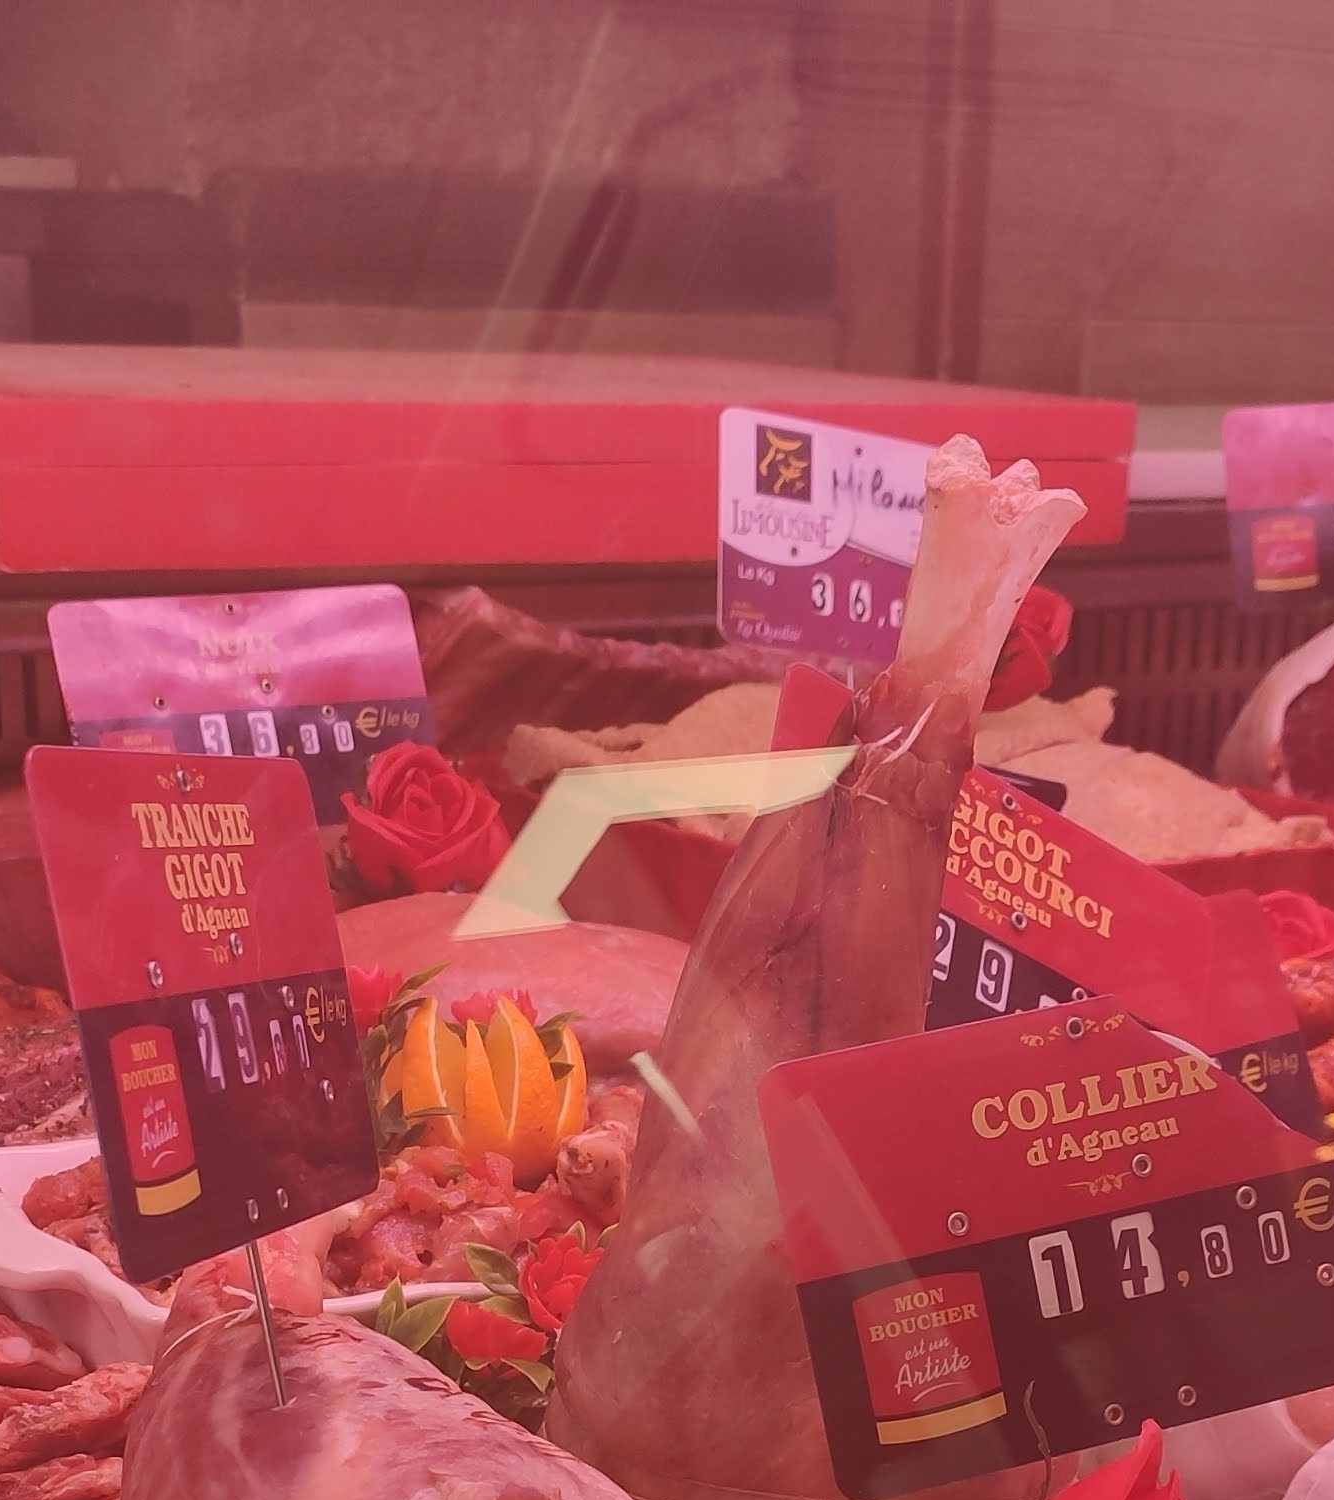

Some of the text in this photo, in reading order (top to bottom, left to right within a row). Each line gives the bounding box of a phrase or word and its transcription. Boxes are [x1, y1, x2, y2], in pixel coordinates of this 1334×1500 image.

[132, 802, 255, 849] TRANCHE
[165, 852, 246, 900] GIGOT
[946, 854, 1052, 929] d'Agneau
[949, 821, 1114, 939] CCOURCI
[182, 903, 250, 940] d'Agneau
[122, 1063, 178, 1092] BOUCHER
[970, 1054, 1217, 1140] COLLIER
[1025, 1114, 1180, 1167] d'Agneau
[869, 1304, 979, 1342] BOUCHER
[894, 1288, 944, 1313] MON
[894, 1347, 971, 1395] Artiste
[905, 1337, 950, 1360] est un
